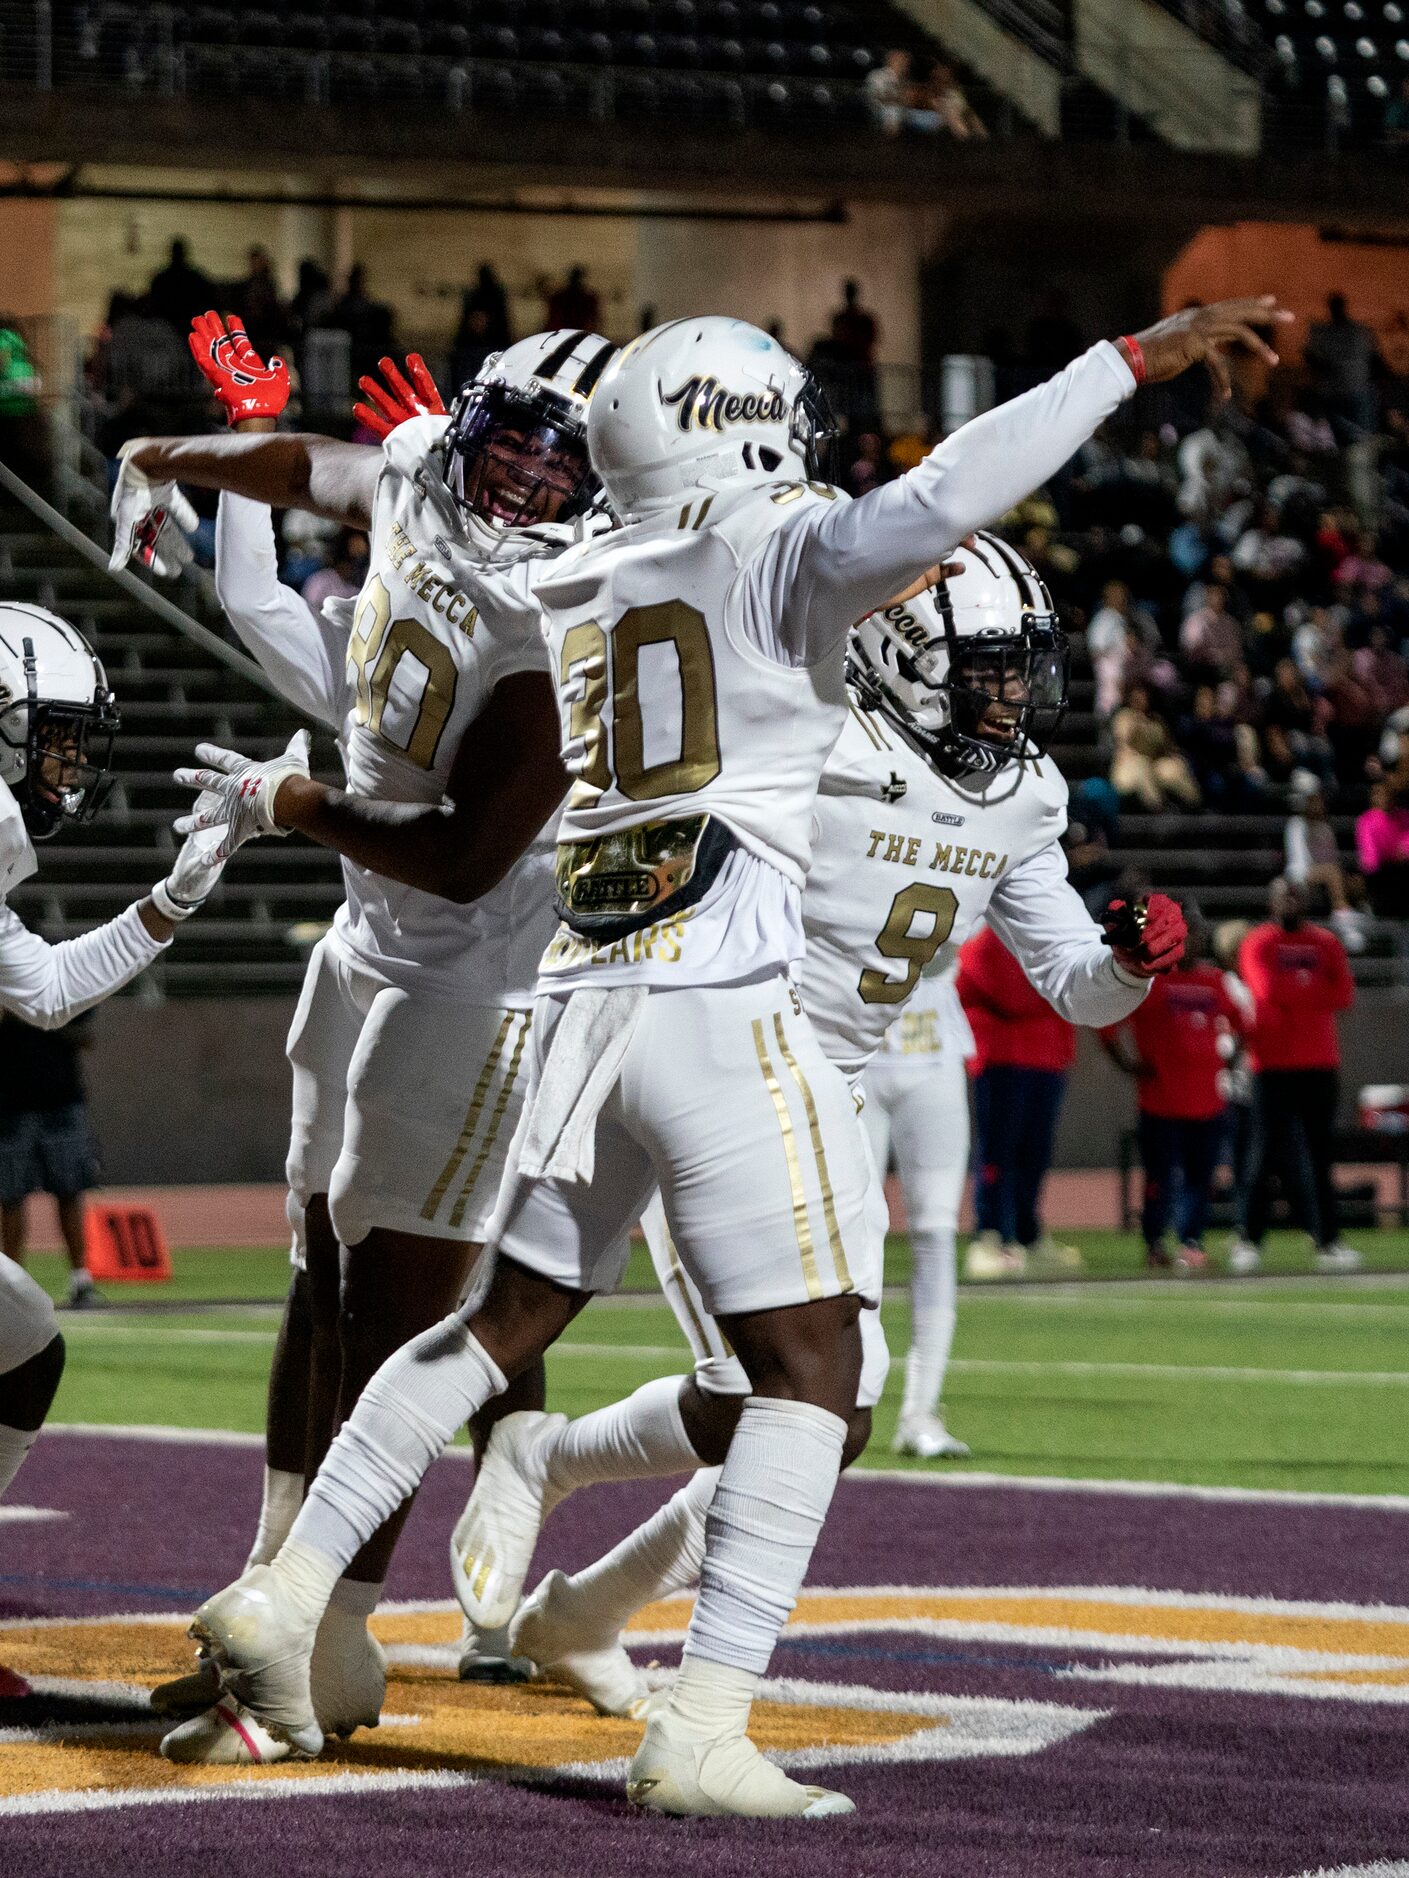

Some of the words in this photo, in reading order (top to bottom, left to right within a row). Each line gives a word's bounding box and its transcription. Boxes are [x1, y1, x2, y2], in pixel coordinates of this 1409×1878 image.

[658, 375, 789, 433] Mecca
[404, 560, 480, 639] MECCA
[866, 829, 922, 866] THE
[857, 881, 960, 1004] 9
[107, 1212, 159, 1268] 10
